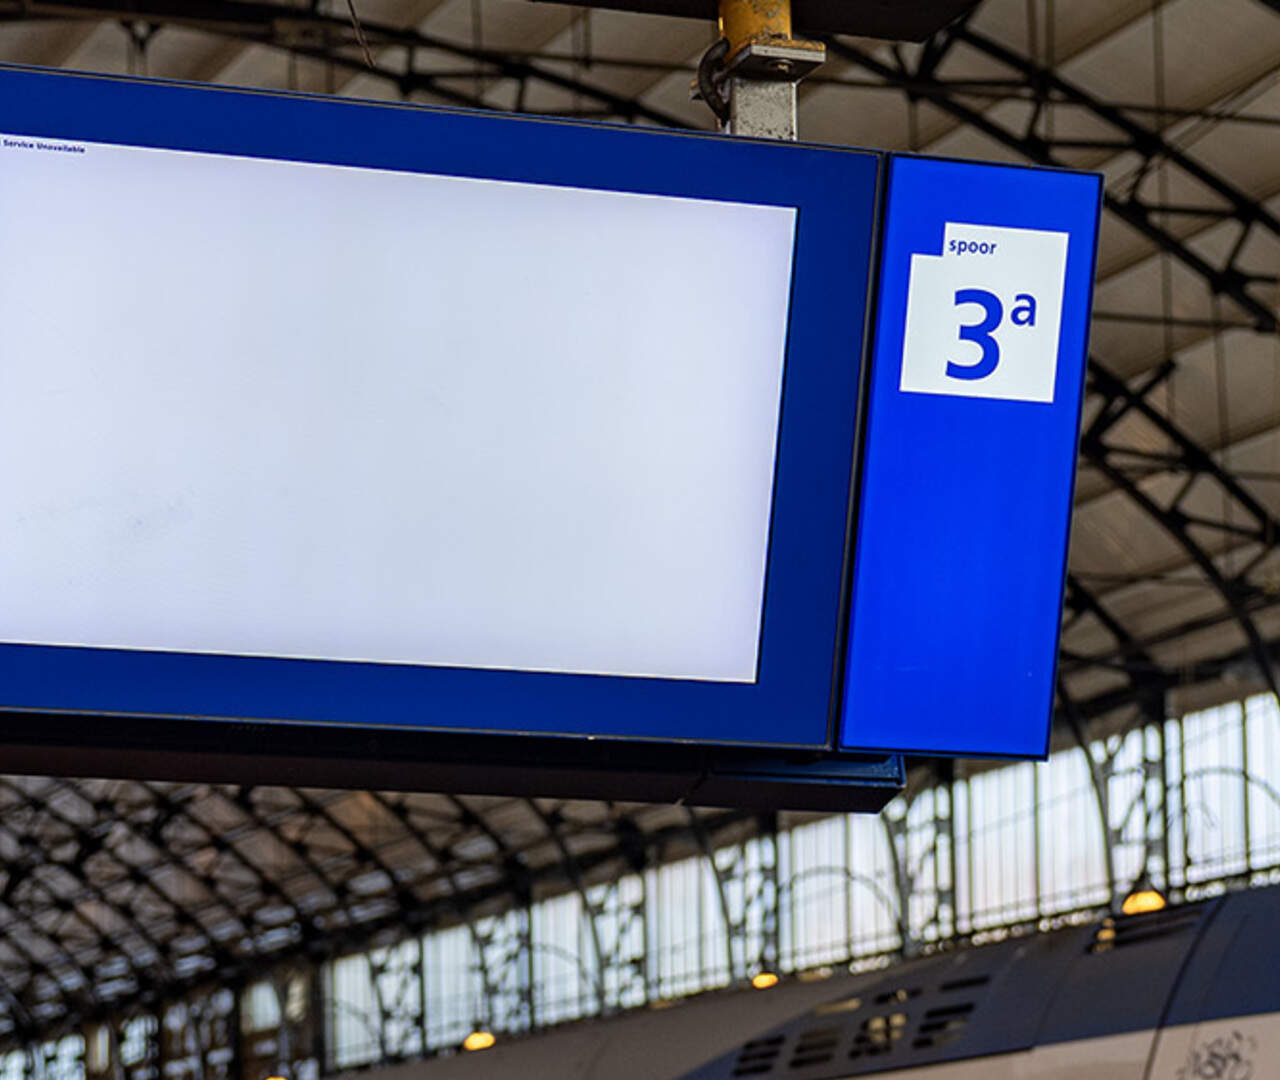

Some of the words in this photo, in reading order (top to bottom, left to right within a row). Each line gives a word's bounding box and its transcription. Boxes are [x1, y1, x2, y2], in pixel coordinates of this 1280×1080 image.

[3, 139, 34, 149] Service
[37, 142, 85, 153] Unavailable
[948, 238, 997, 256] spoor
